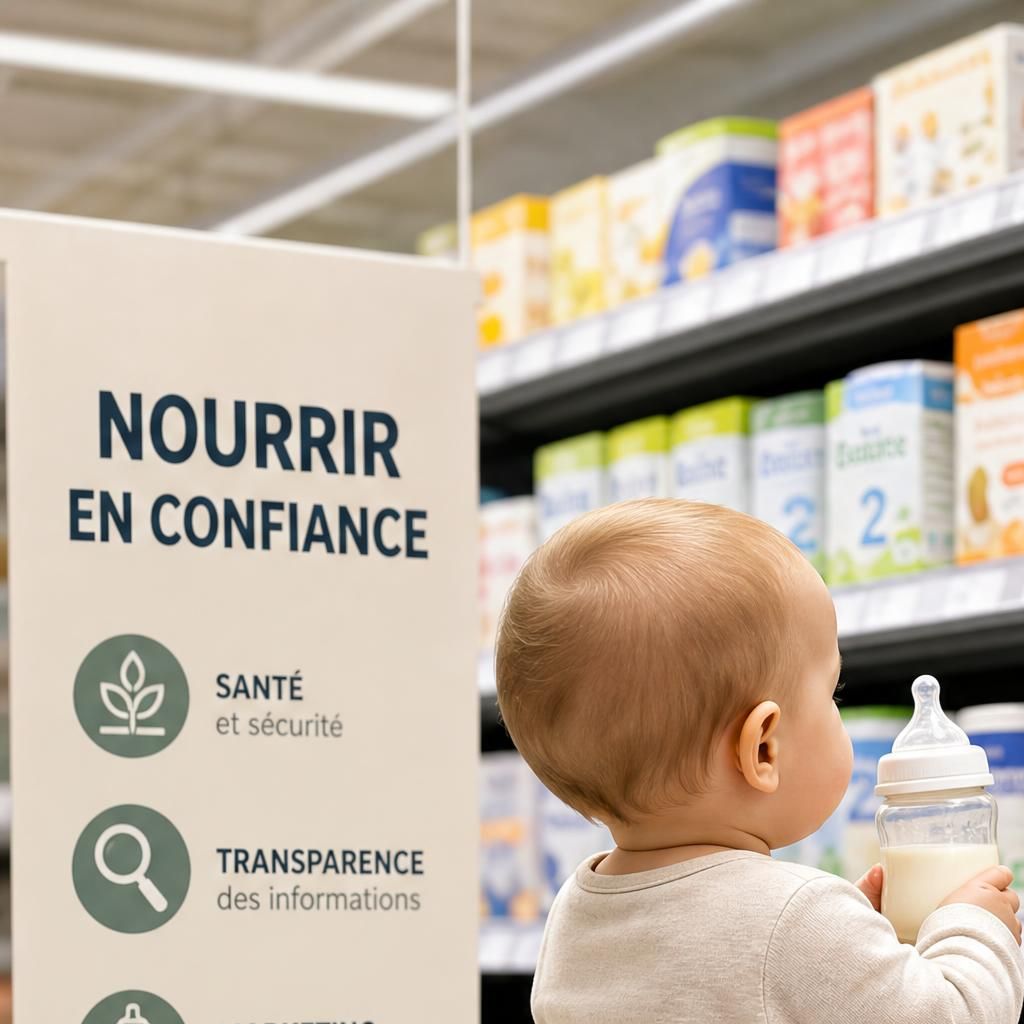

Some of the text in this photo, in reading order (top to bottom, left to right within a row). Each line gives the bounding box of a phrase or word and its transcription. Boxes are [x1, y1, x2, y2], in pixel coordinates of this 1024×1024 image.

[98, 389, 401, 479] NOURRIR
[69, 488, 429, 559] EN CONFIANCE
[784, 497, 817, 550] 2
[860, 487, 887, 545] 2
[215, 670, 304, 701] SANTÉ
[215, 712, 344, 738] et sécurité
[216, 848, 425, 875] TRANSPARENCE
[217, 885, 422, 912] des informations
